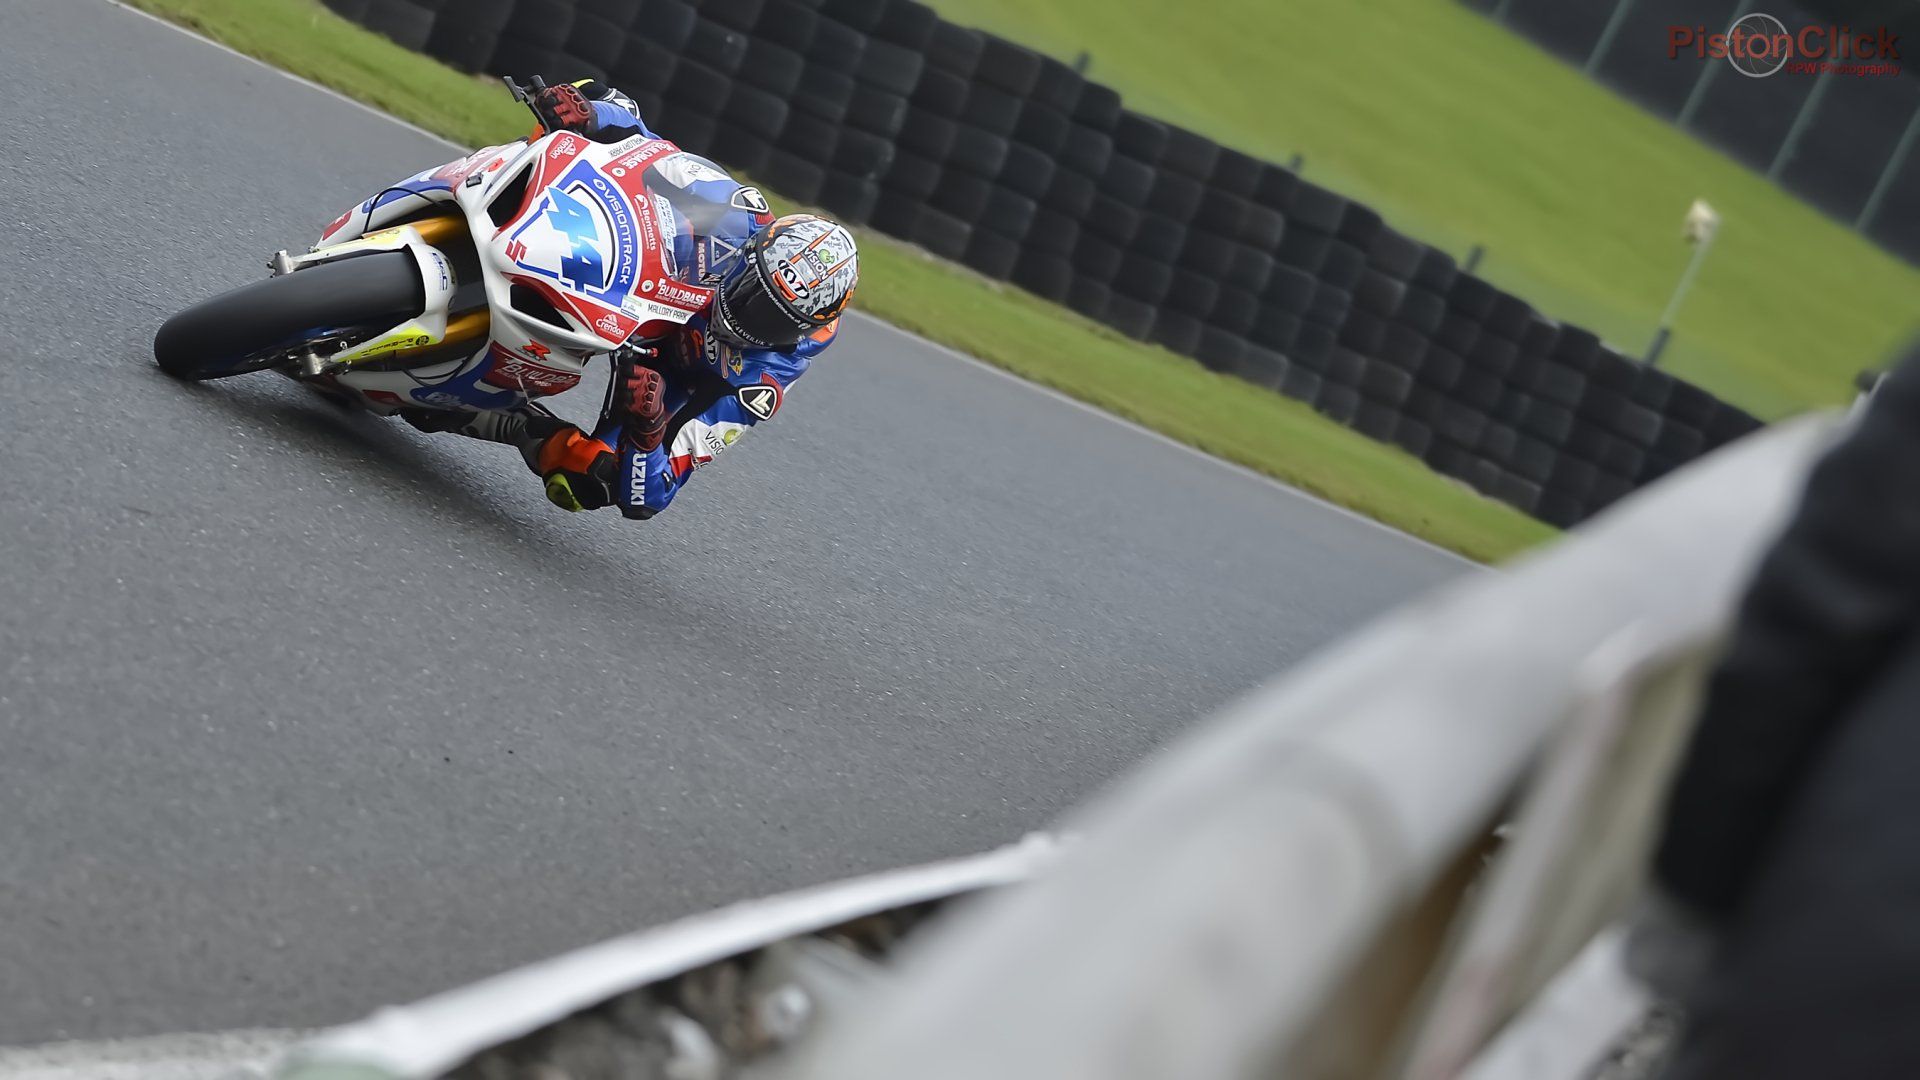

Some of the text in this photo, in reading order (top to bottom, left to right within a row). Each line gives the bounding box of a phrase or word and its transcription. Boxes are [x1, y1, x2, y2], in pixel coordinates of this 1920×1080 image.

[551, 136, 575, 160] Crendon
[643, 210, 656, 250] Bennetts
[804, 247, 829, 280] VISION
[778, 259, 809, 299] KYT
[657, 285, 706, 305] BUILDBASE
[647, 304, 673, 319] MALLORY
[673, 309, 688, 321] PARK
[595, 318, 625, 336] Crendon
[630, 452, 647, 505] UZUKI
